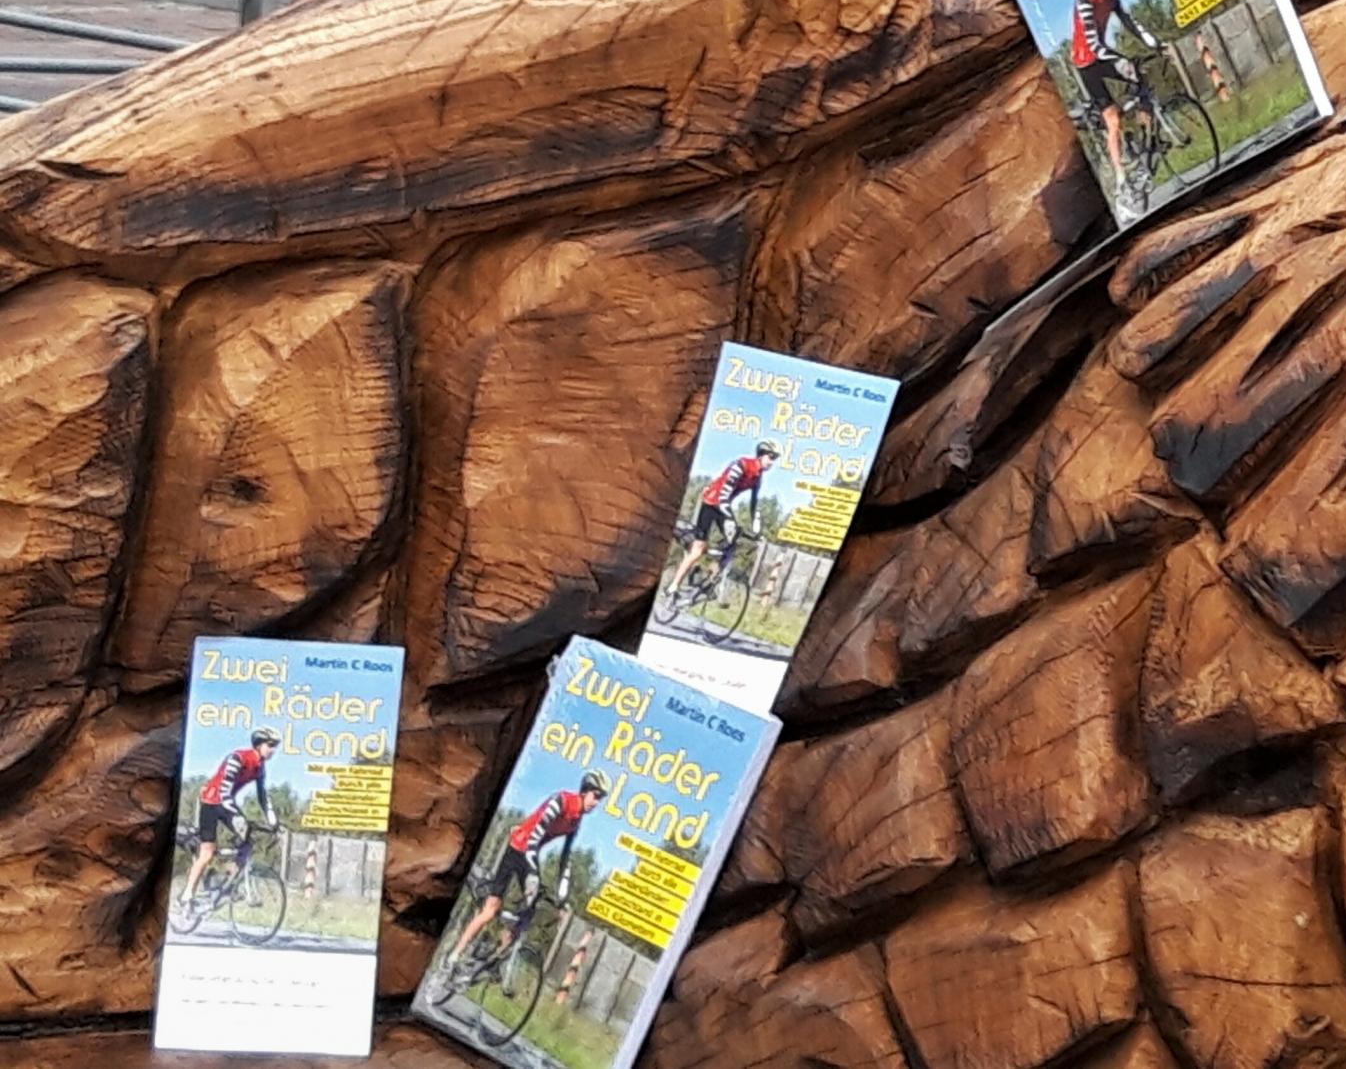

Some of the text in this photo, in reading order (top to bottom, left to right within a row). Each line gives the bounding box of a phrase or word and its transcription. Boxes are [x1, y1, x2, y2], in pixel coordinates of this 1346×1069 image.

[723, 356, 803, 402] Zwei
[711, 406, 762, 439] ein
[772, 401, 873, 450] Räder
[780, 436, 867, 482] Land
[201, 649, 290, 684] Zwei
[305, 656, 394, 673] Martin C Roos
[263, 684, 384, 724] Räder
[565, 656, 655, 723] Zwei
[195, 699, 253, 731] ein
[664, 696, 747, 743] Martin C Roos
[283, 722, 388, 759] Land
[541, 722, 596, 768] ein
[603, 720, 721, 802] Räder
[603, 772, 710, 849] Land
